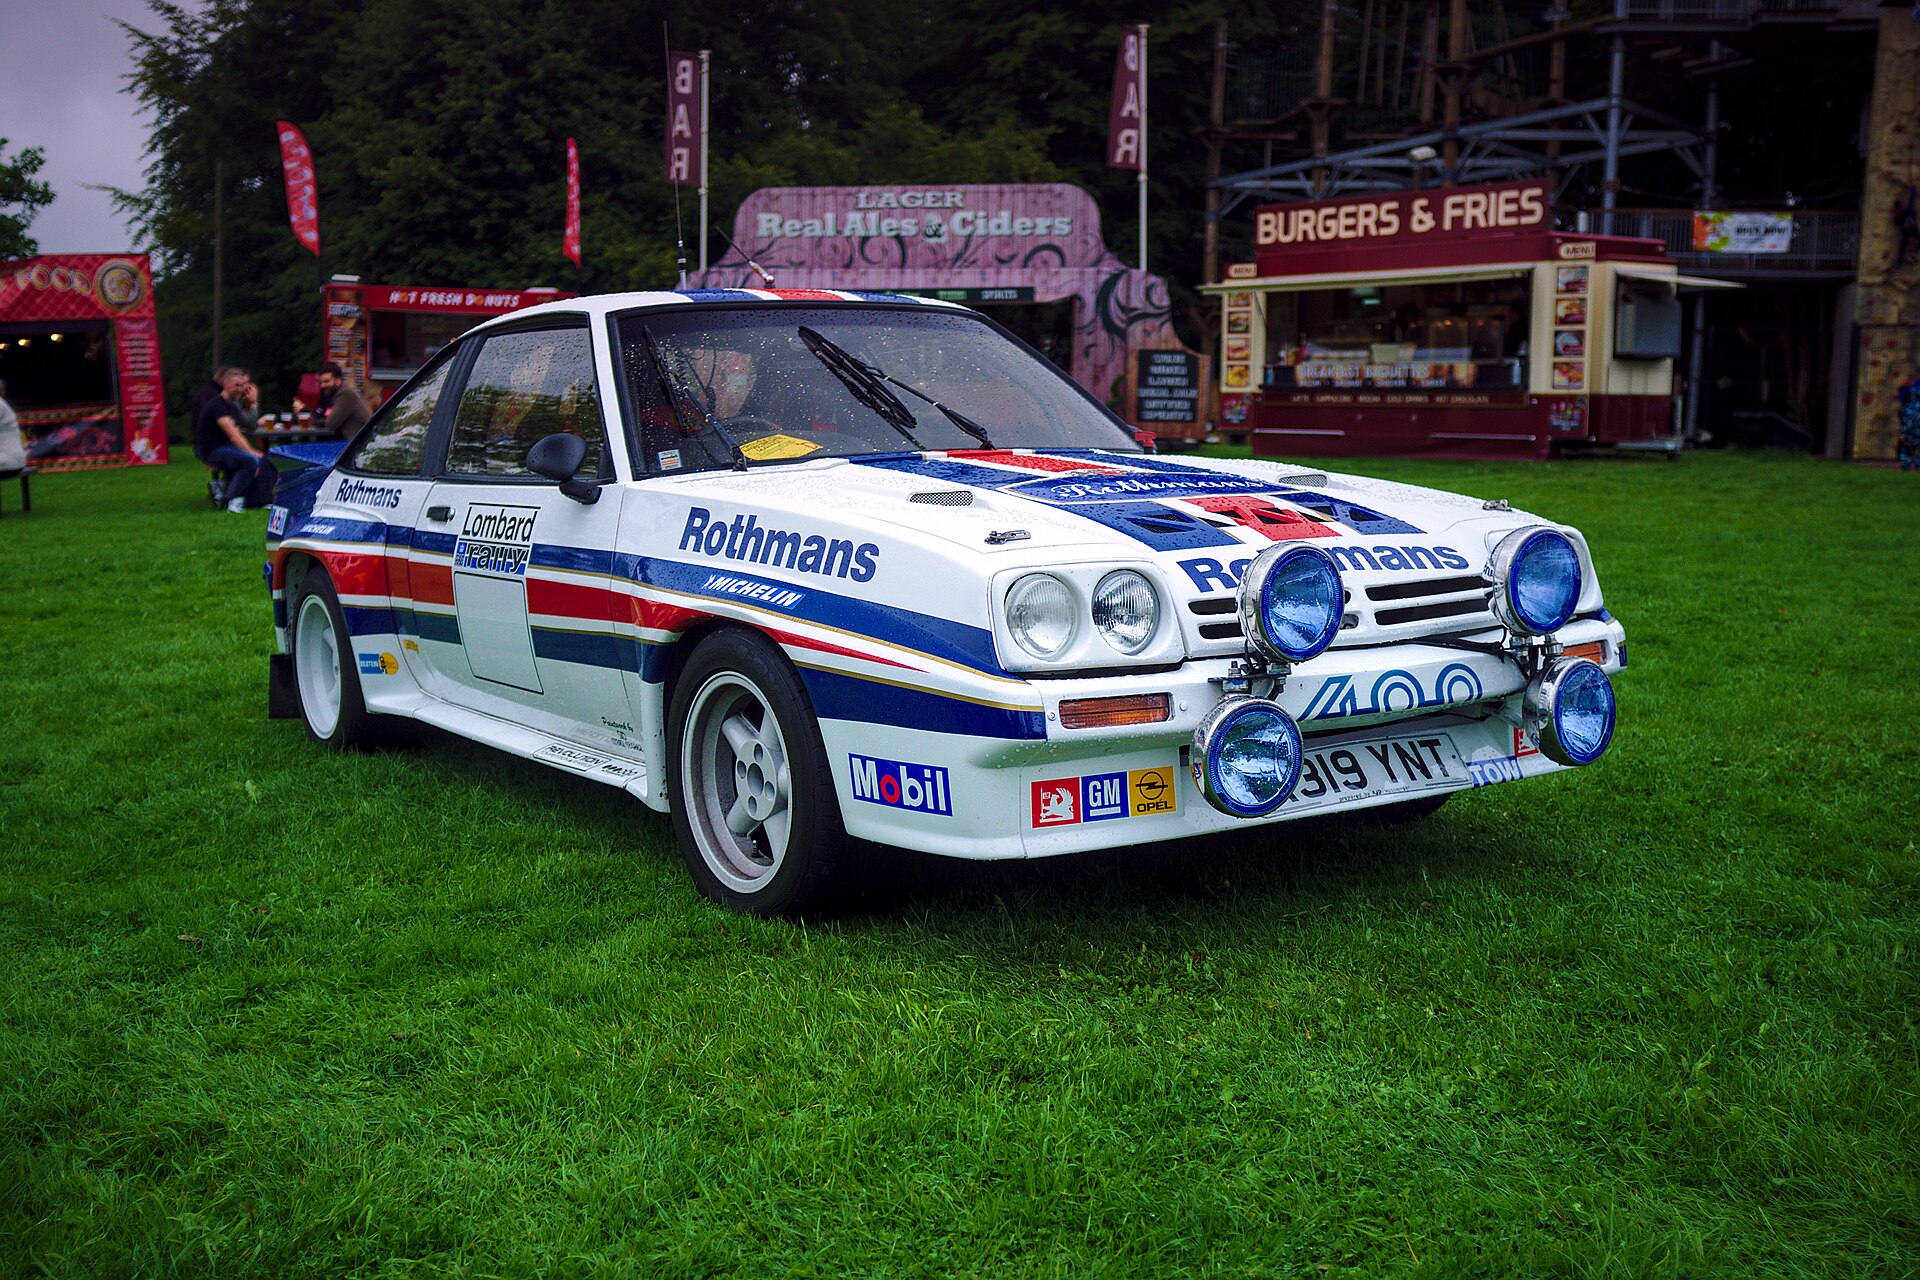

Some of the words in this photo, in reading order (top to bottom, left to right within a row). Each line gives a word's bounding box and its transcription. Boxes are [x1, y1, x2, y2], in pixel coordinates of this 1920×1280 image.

[855, 191, 965, 209] LAGER
[757, 211, 837, 238] Real
[842, 211, 920, 237] Ales
[921, 211, 948, 242] &
[951, 210, 1073, 238] Ciders
[1257, 201, 1400, 245] BURGERS
[1411, 198, 1436, 233] &
[1443, 187, 1544, 231] FRIES
[1566, 245, 1595, 256] MENU
[389, 291, 417, 304] HOT
[420, 292, 464, 306] FRESH
[465, 293, 520, 308] DONUTS
[1299, 364, 1361, 378] BREAKFAST
[1365, 364, 1429, 378] BAGUETTES
[335, 478, 402, 509] Rothmans
[1051, 479, 1267, 498] Rothmans
[462, 506, 538, 542] Lombard
[466, 544, 528, 573] rally
[678, 506, 880, 583] Rothmans
[1176, 546, 1470, 593] Romans
[711, 575, 802, 607] MICHELIN
[1297, 663, 1483, 722] 400
[1365, 738, 1450, 783] YNT
[1468, 760, 1521, 787] TOW
[851, 757, 947, 812] Mobil
[1088, 777, 1121, 808] GM
[1136, 799, 1173, 813] OPEL
